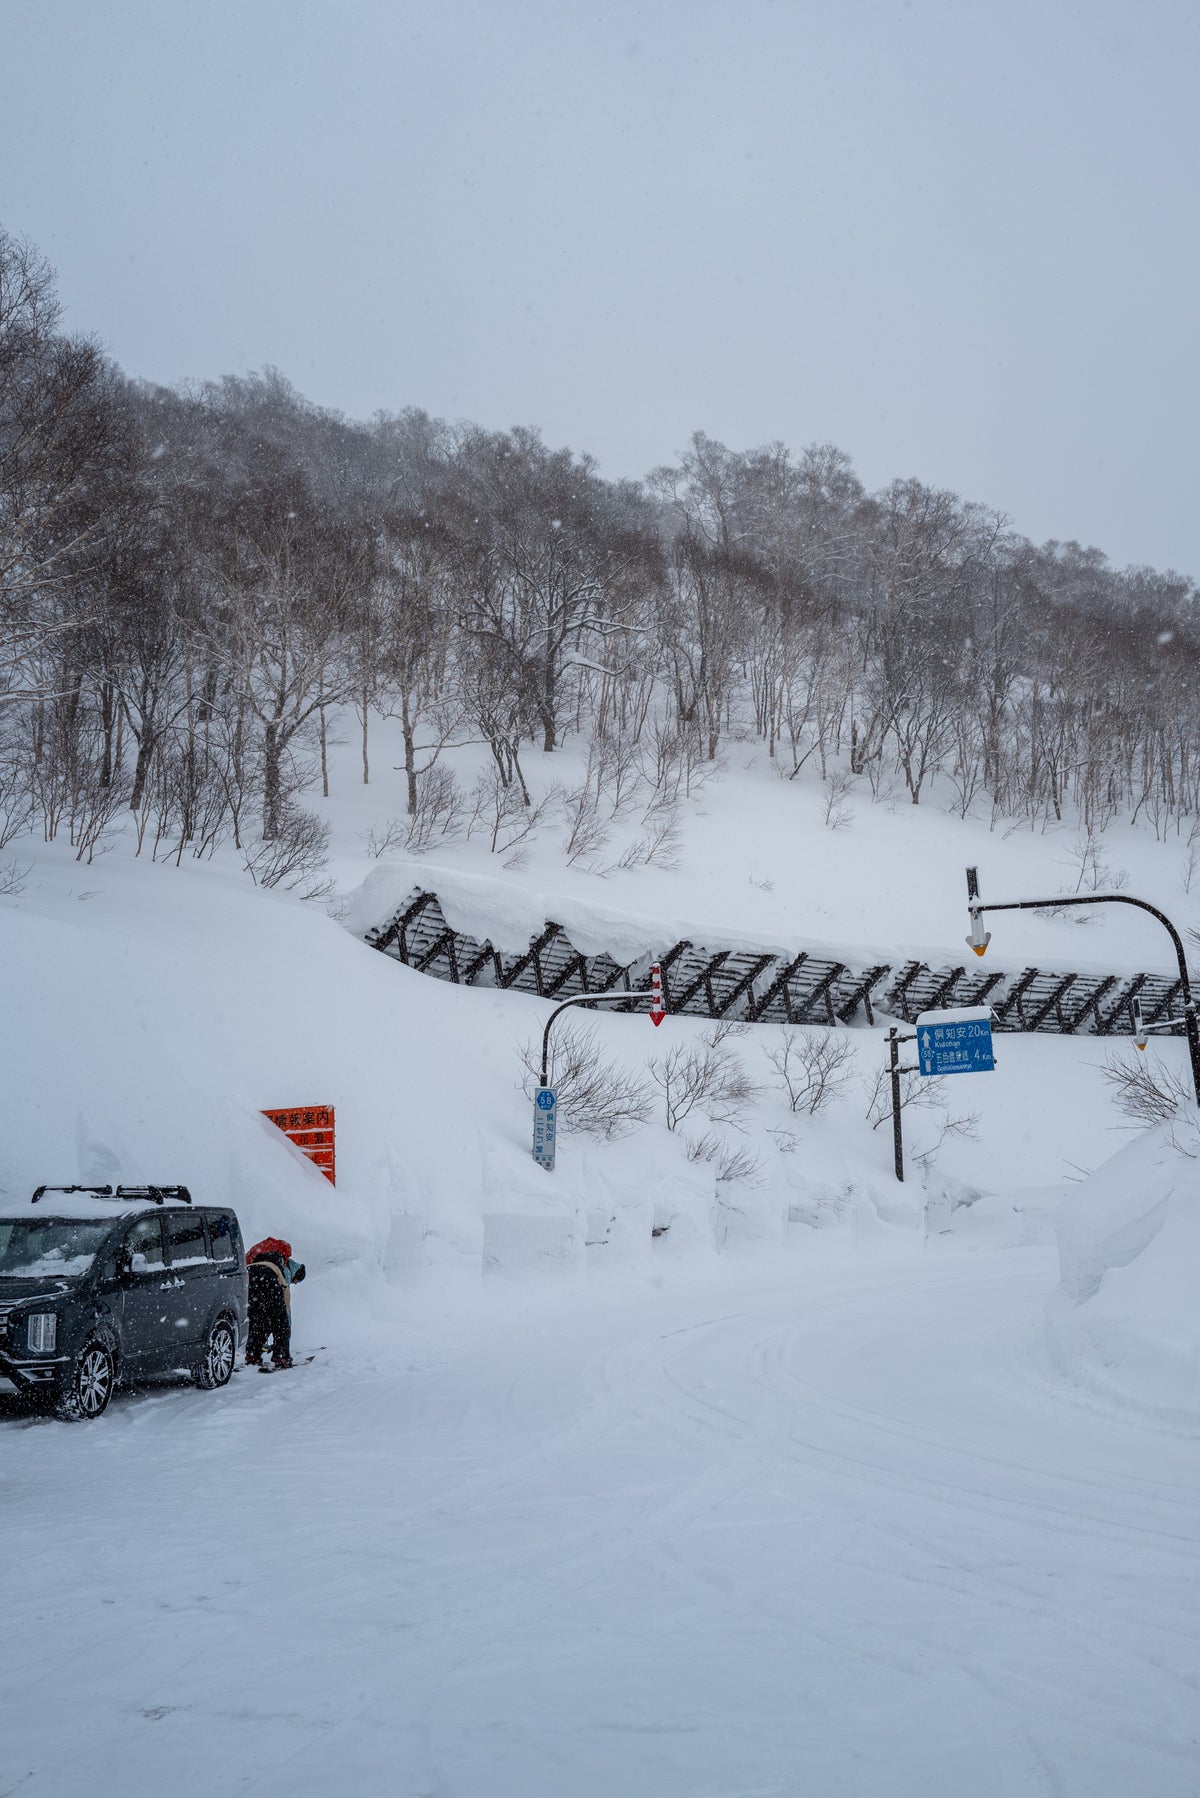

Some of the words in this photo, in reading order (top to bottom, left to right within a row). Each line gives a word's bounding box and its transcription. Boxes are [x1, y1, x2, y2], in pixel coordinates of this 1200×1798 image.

[923, 1050, 931, 1058] 58
[540, 1096, 552, 1105] 58
[267, 1111, 329, 1127] 情報案内
